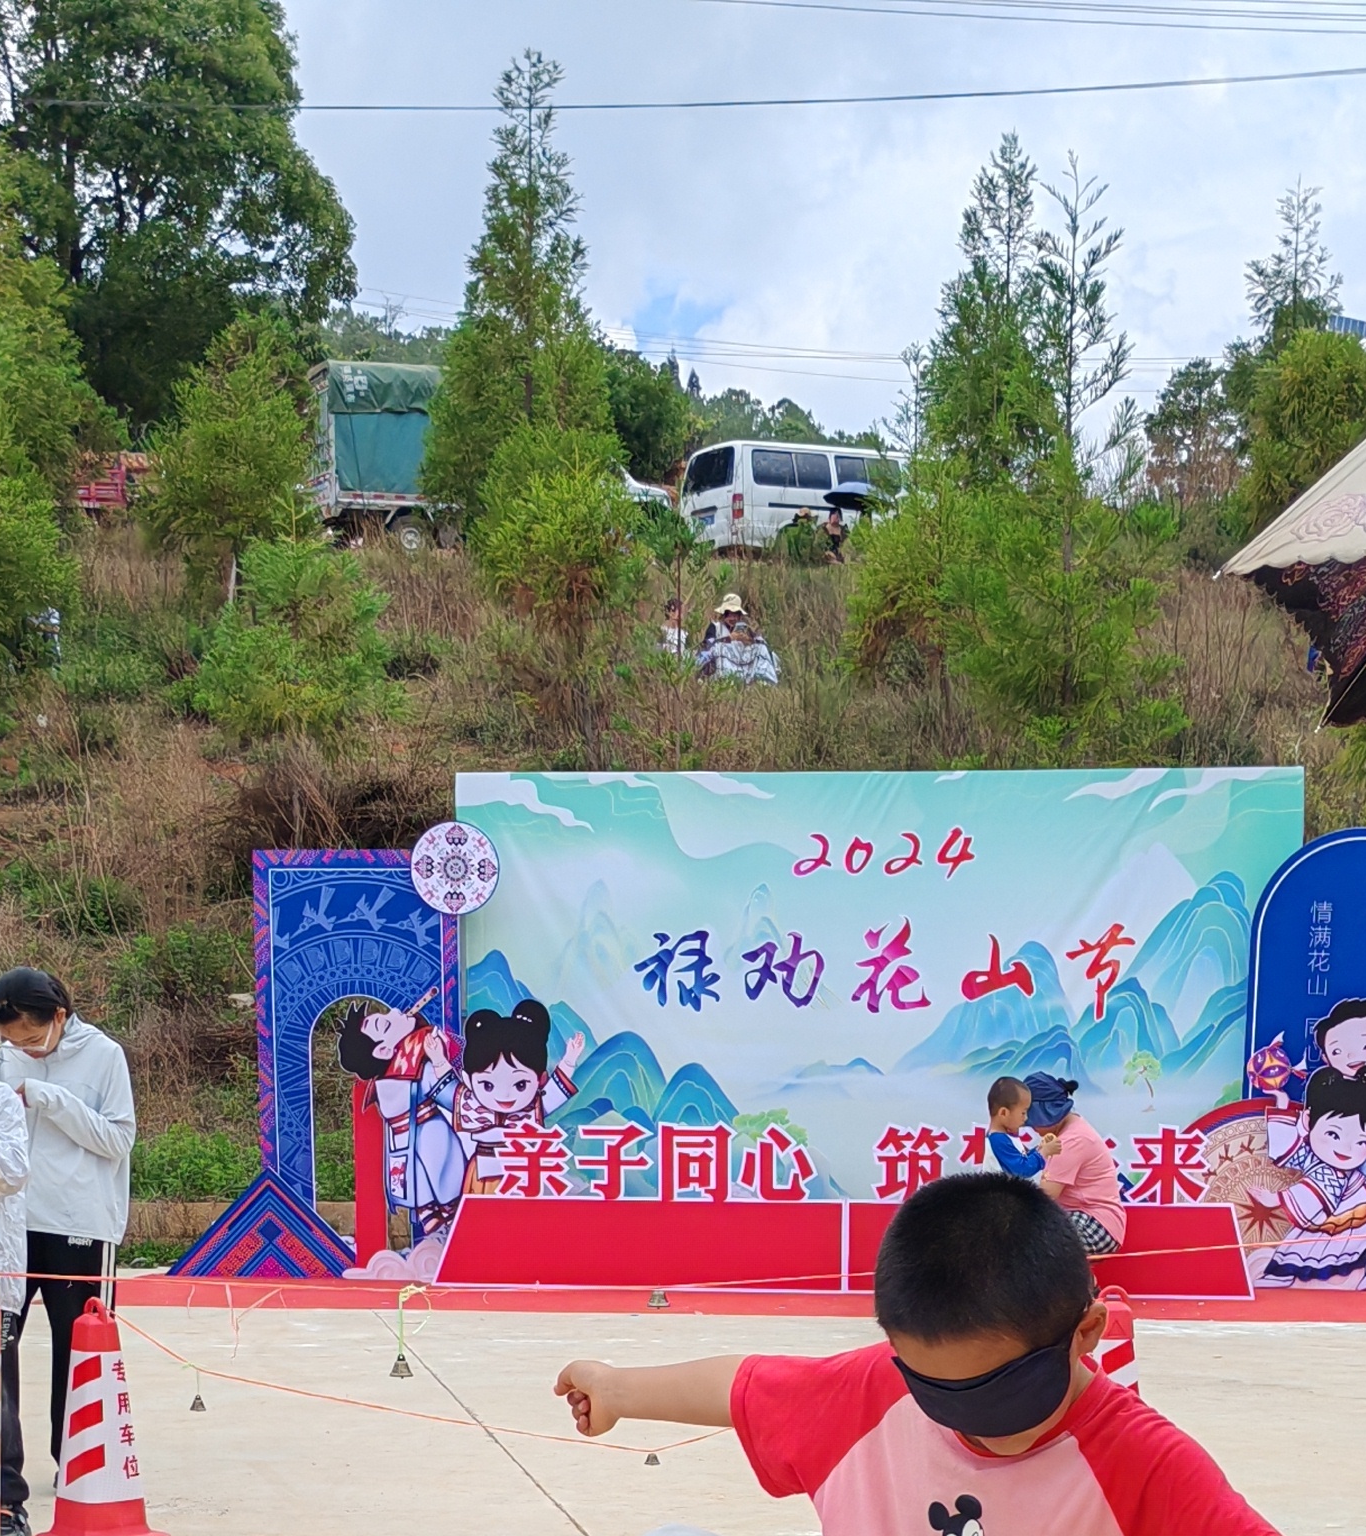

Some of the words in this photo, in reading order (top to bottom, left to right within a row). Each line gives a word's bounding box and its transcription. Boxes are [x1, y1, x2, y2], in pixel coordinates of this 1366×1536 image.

[792, 827, 976, 880] 2024
[633, 916, 1136, 1020] 禄劝花山节
[1306, 901, 1333, 997] 情满花山
[497, 1122, 819, 1201] 亲子同心
[874, 1124, 1210, 1205] 筑来
[111, 1359, 140, 1479] 专用车位
